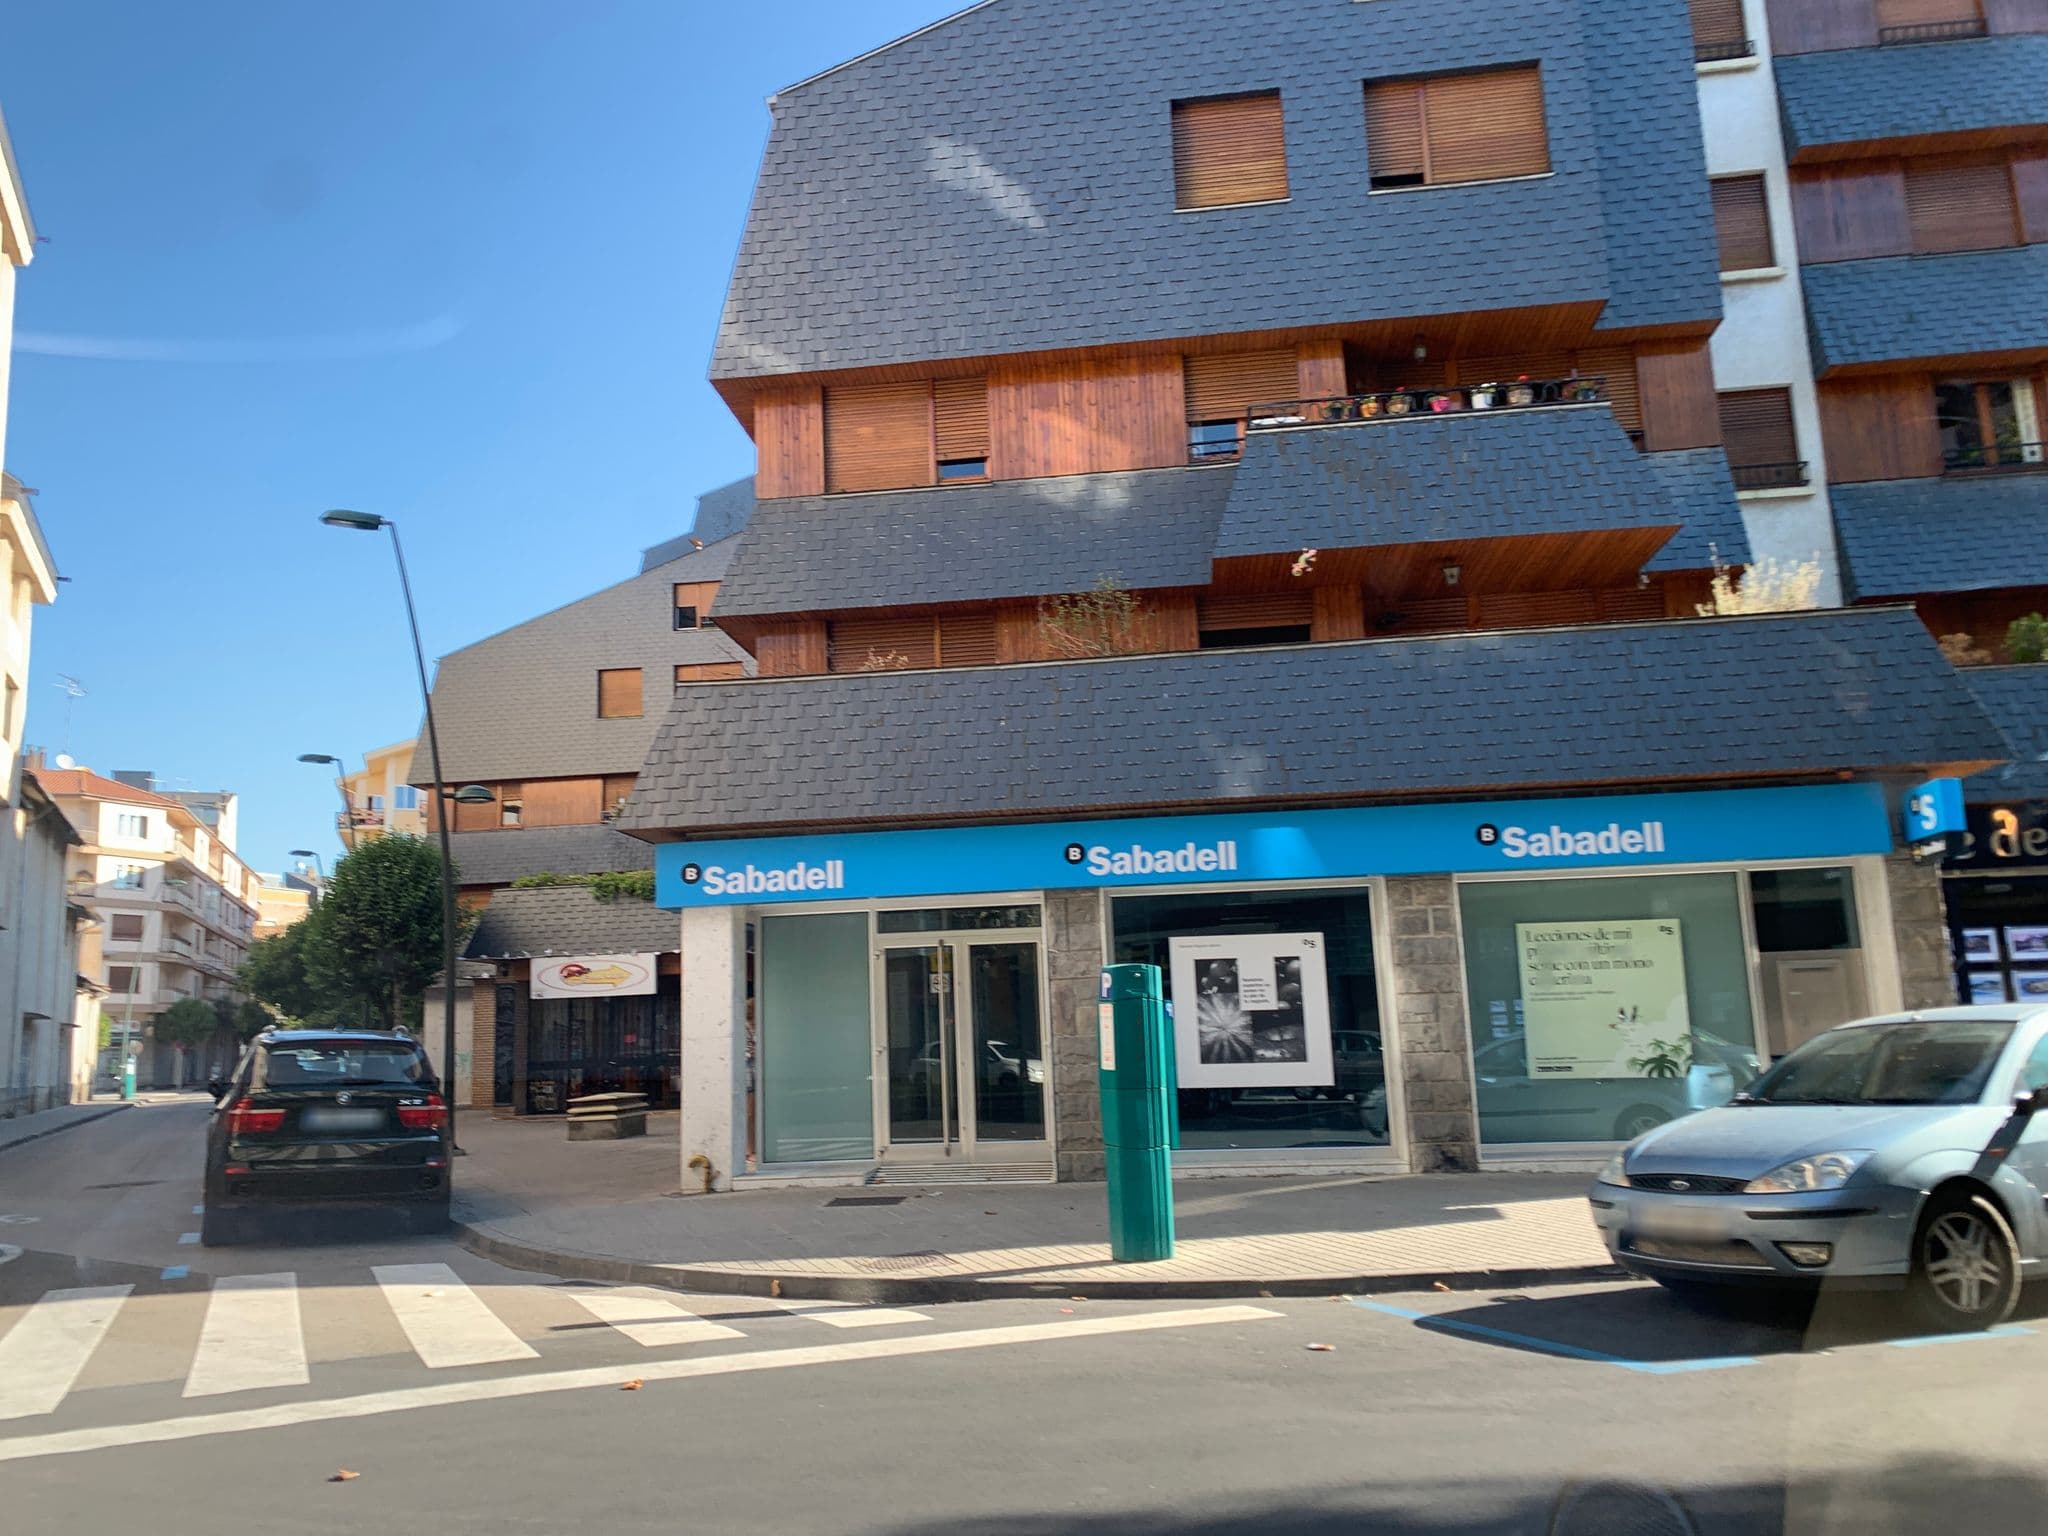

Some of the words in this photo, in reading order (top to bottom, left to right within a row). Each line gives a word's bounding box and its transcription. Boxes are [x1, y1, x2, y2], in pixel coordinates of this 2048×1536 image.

[1086, 840, 1238, 876] Sabadell
[1501, 821, 1665, 858] Sabadell
[702, 859, 844, 896] Sabadell
